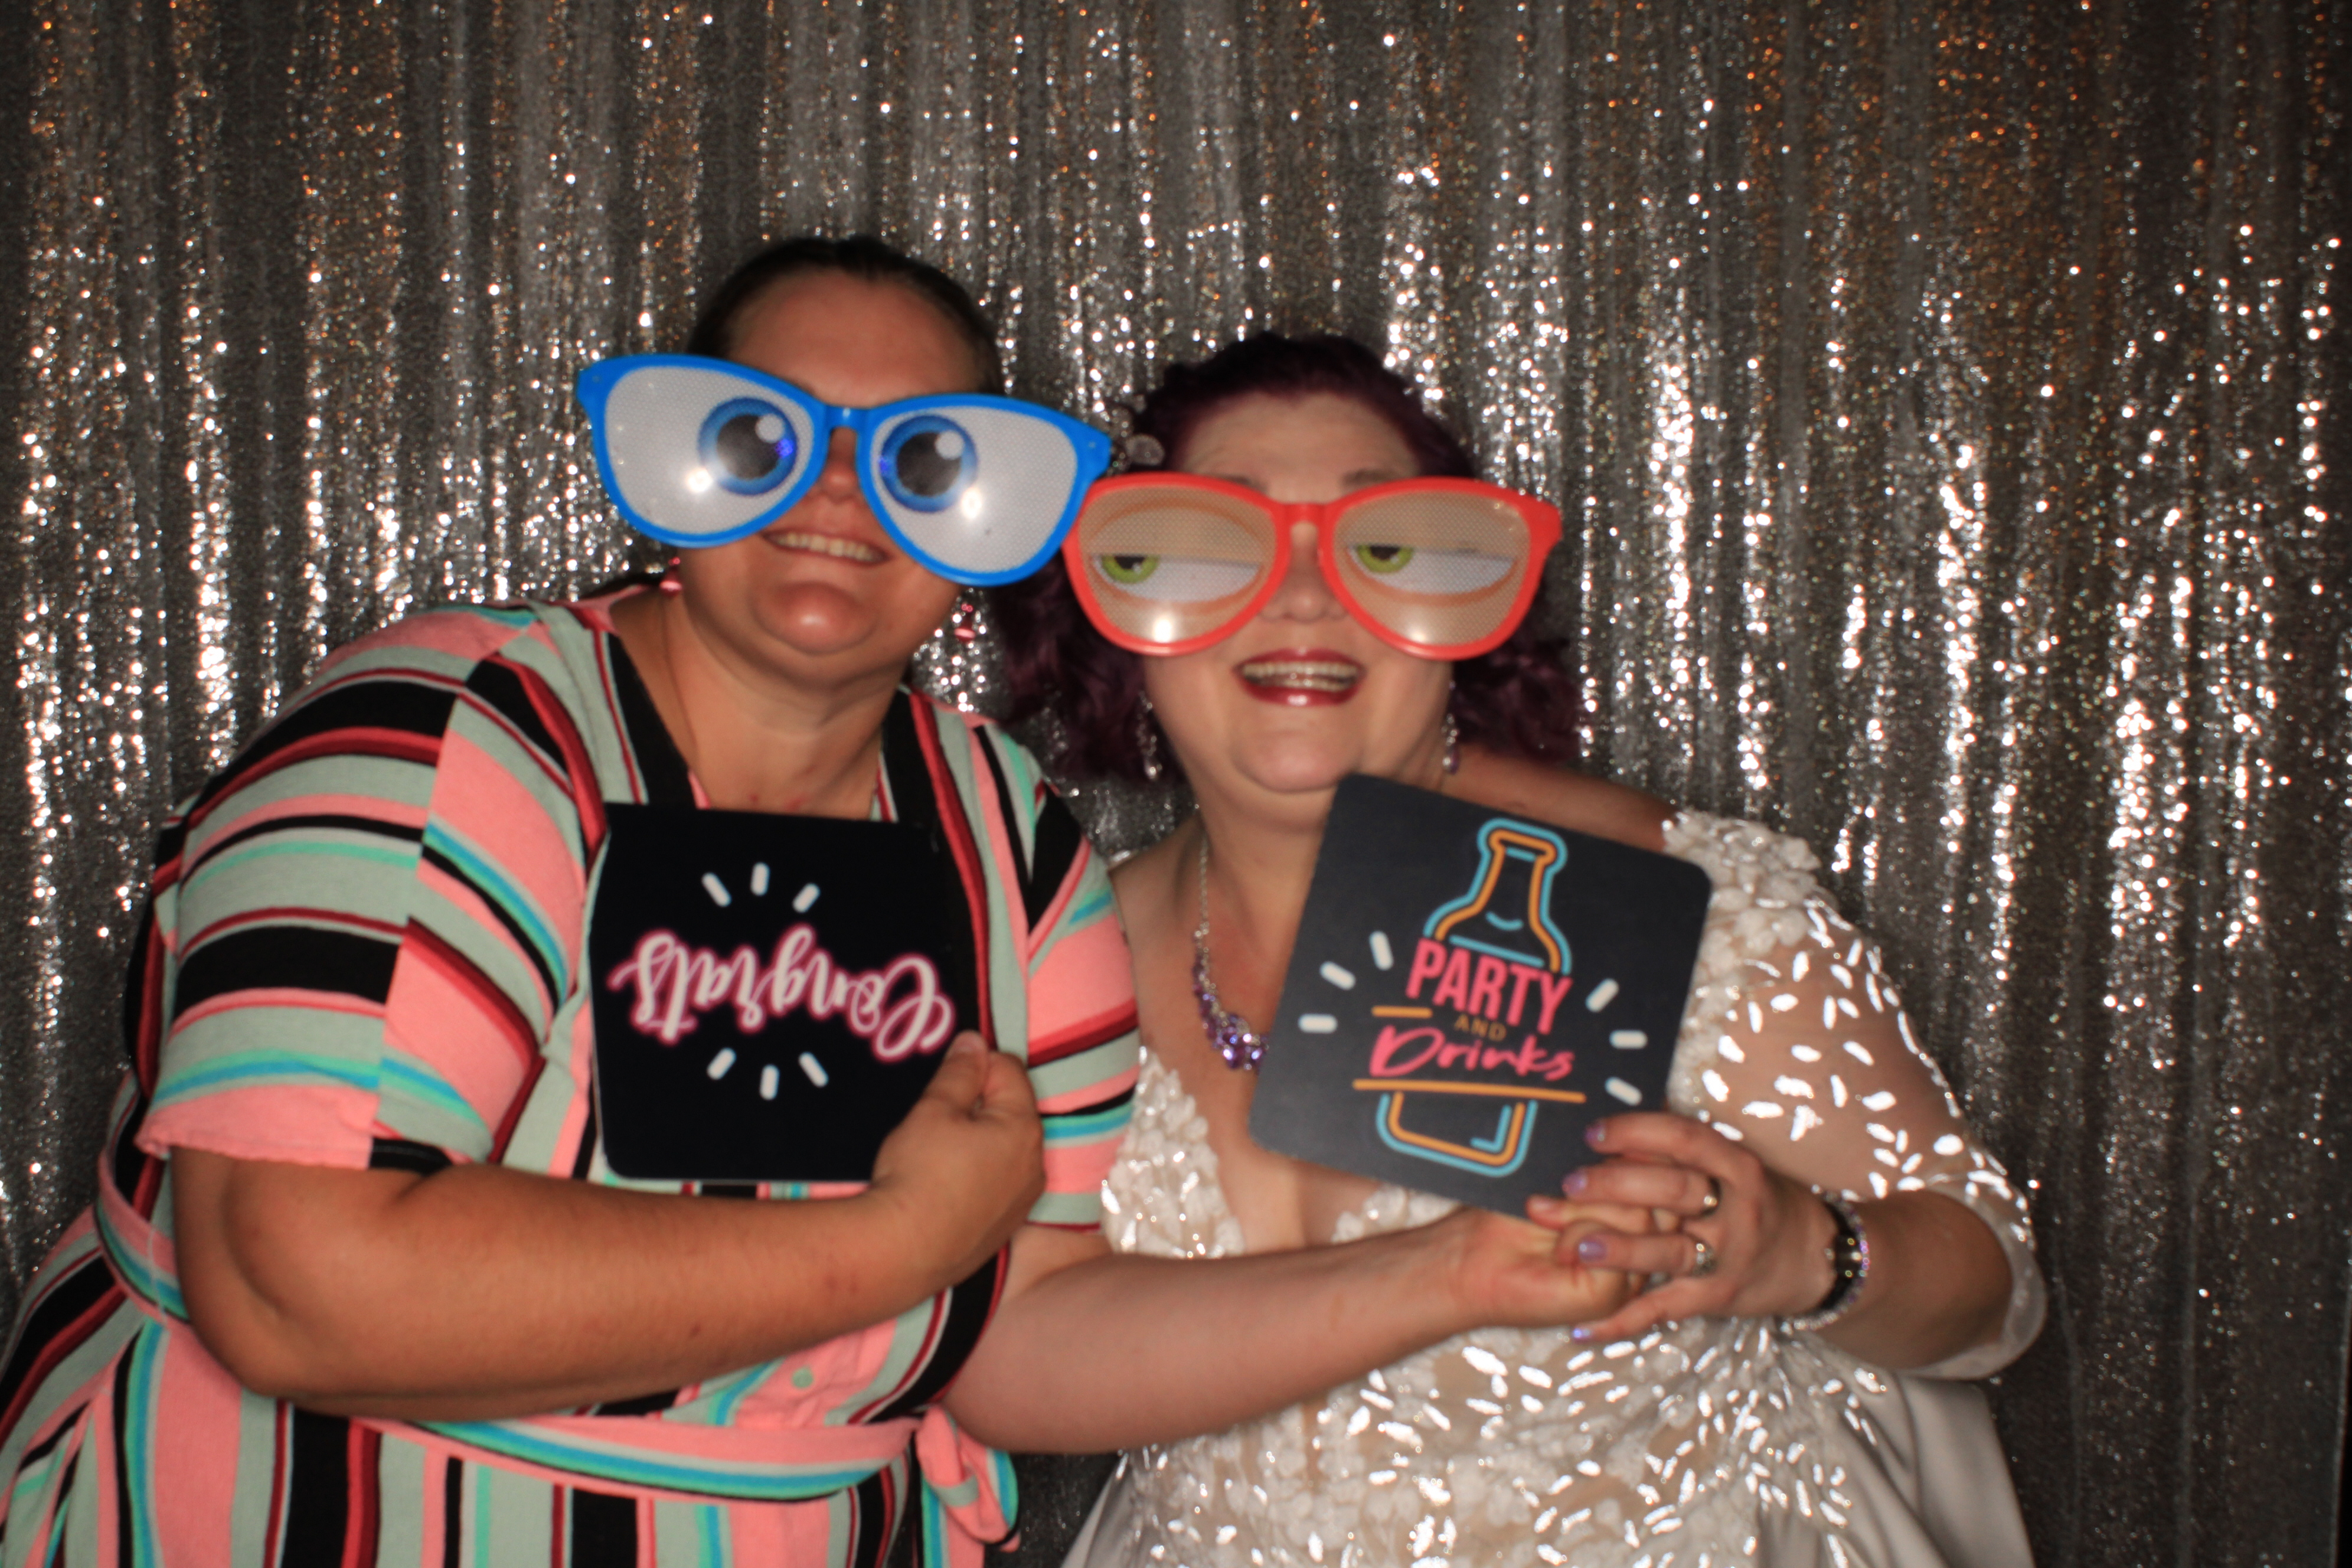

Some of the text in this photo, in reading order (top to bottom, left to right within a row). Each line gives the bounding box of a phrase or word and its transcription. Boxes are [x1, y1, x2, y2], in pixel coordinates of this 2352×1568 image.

[609, 925, 955, 1060] Congrats
[1406, 938, 1573, 1034] PARTY
[1369, 1025, 1575, 1080] Drinks
[1455, 1015, 1507, 1041] AND
